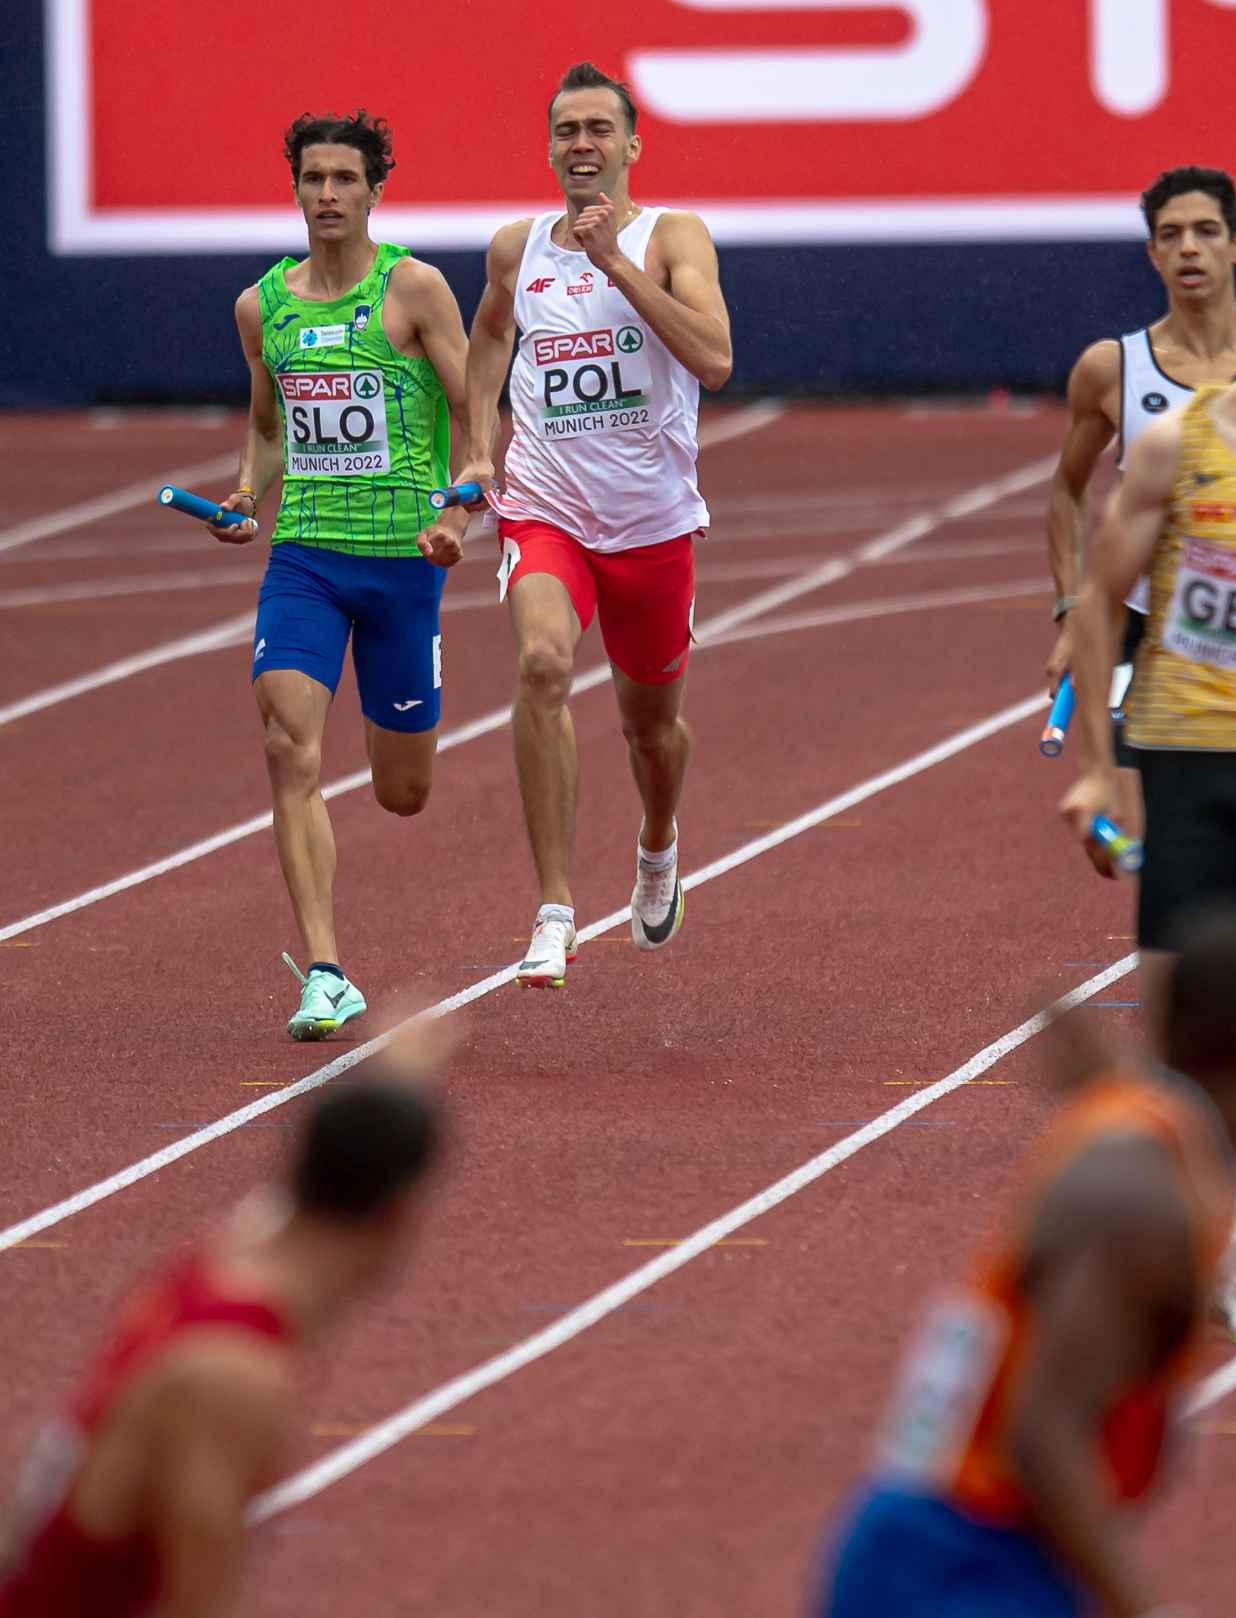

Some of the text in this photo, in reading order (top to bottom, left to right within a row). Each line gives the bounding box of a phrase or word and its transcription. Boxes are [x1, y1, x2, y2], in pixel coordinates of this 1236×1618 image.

[567, 285, 593, 294] ORLEN
[320, 329, 344, 337] Telekom
[536, 333, 612, 361] SPAR
[282, 377, 350, 397] SPAR
[544, 361, 642, 408] POL
[565, 404, 587, 414] RUN
[292, 404, 375, 444] SLO
[544, 409, 650, 436] MUNICH 2022
[307, 444, 326, 453] RUN
[292, 455, 383, 471] MUNICH 2022
